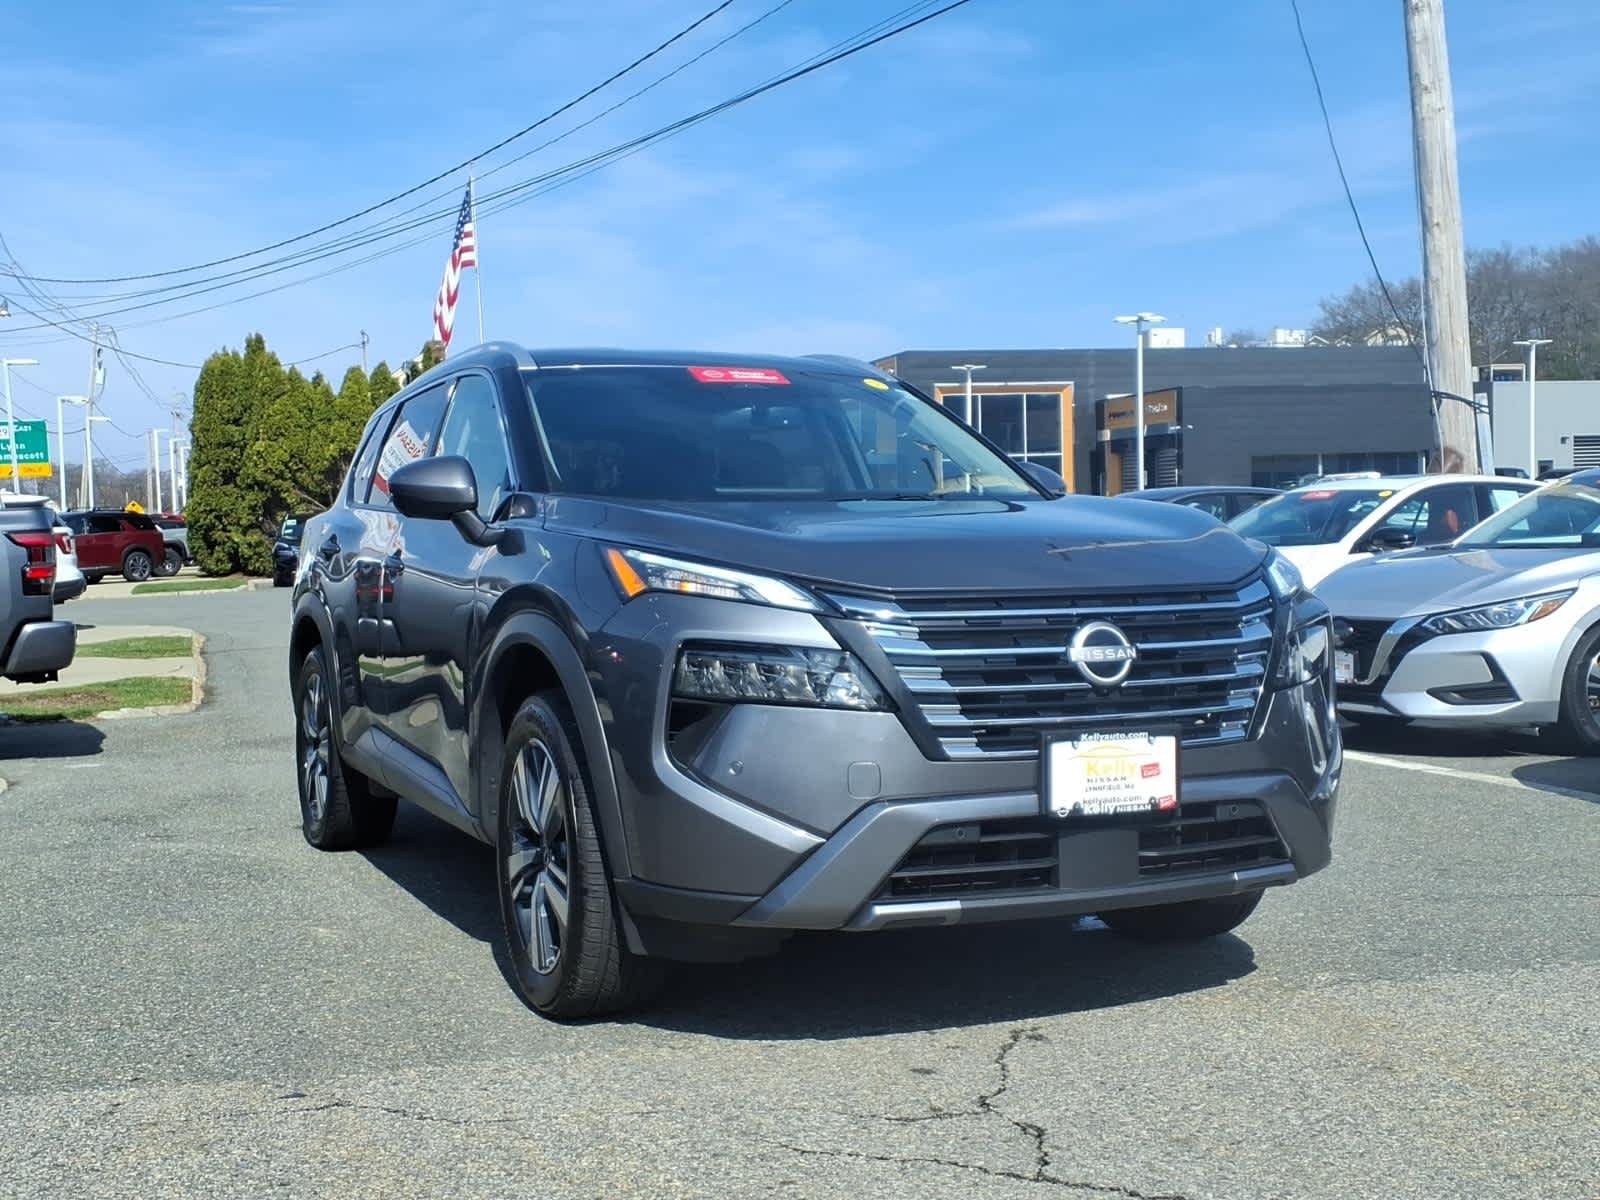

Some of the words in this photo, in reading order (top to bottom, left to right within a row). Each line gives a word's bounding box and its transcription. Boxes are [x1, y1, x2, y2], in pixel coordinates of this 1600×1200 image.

[0, 452, 44, 460] amscott
[1071, 647, 1137, 660] NISSAN
[1081, 732, 1148, 743] Kellyauto.com
[1086, 760, 1137, 777] Kelly
[1086, 776, 1127, 784] NISSAN
[1084, 803, 1115, 815] Kelly
